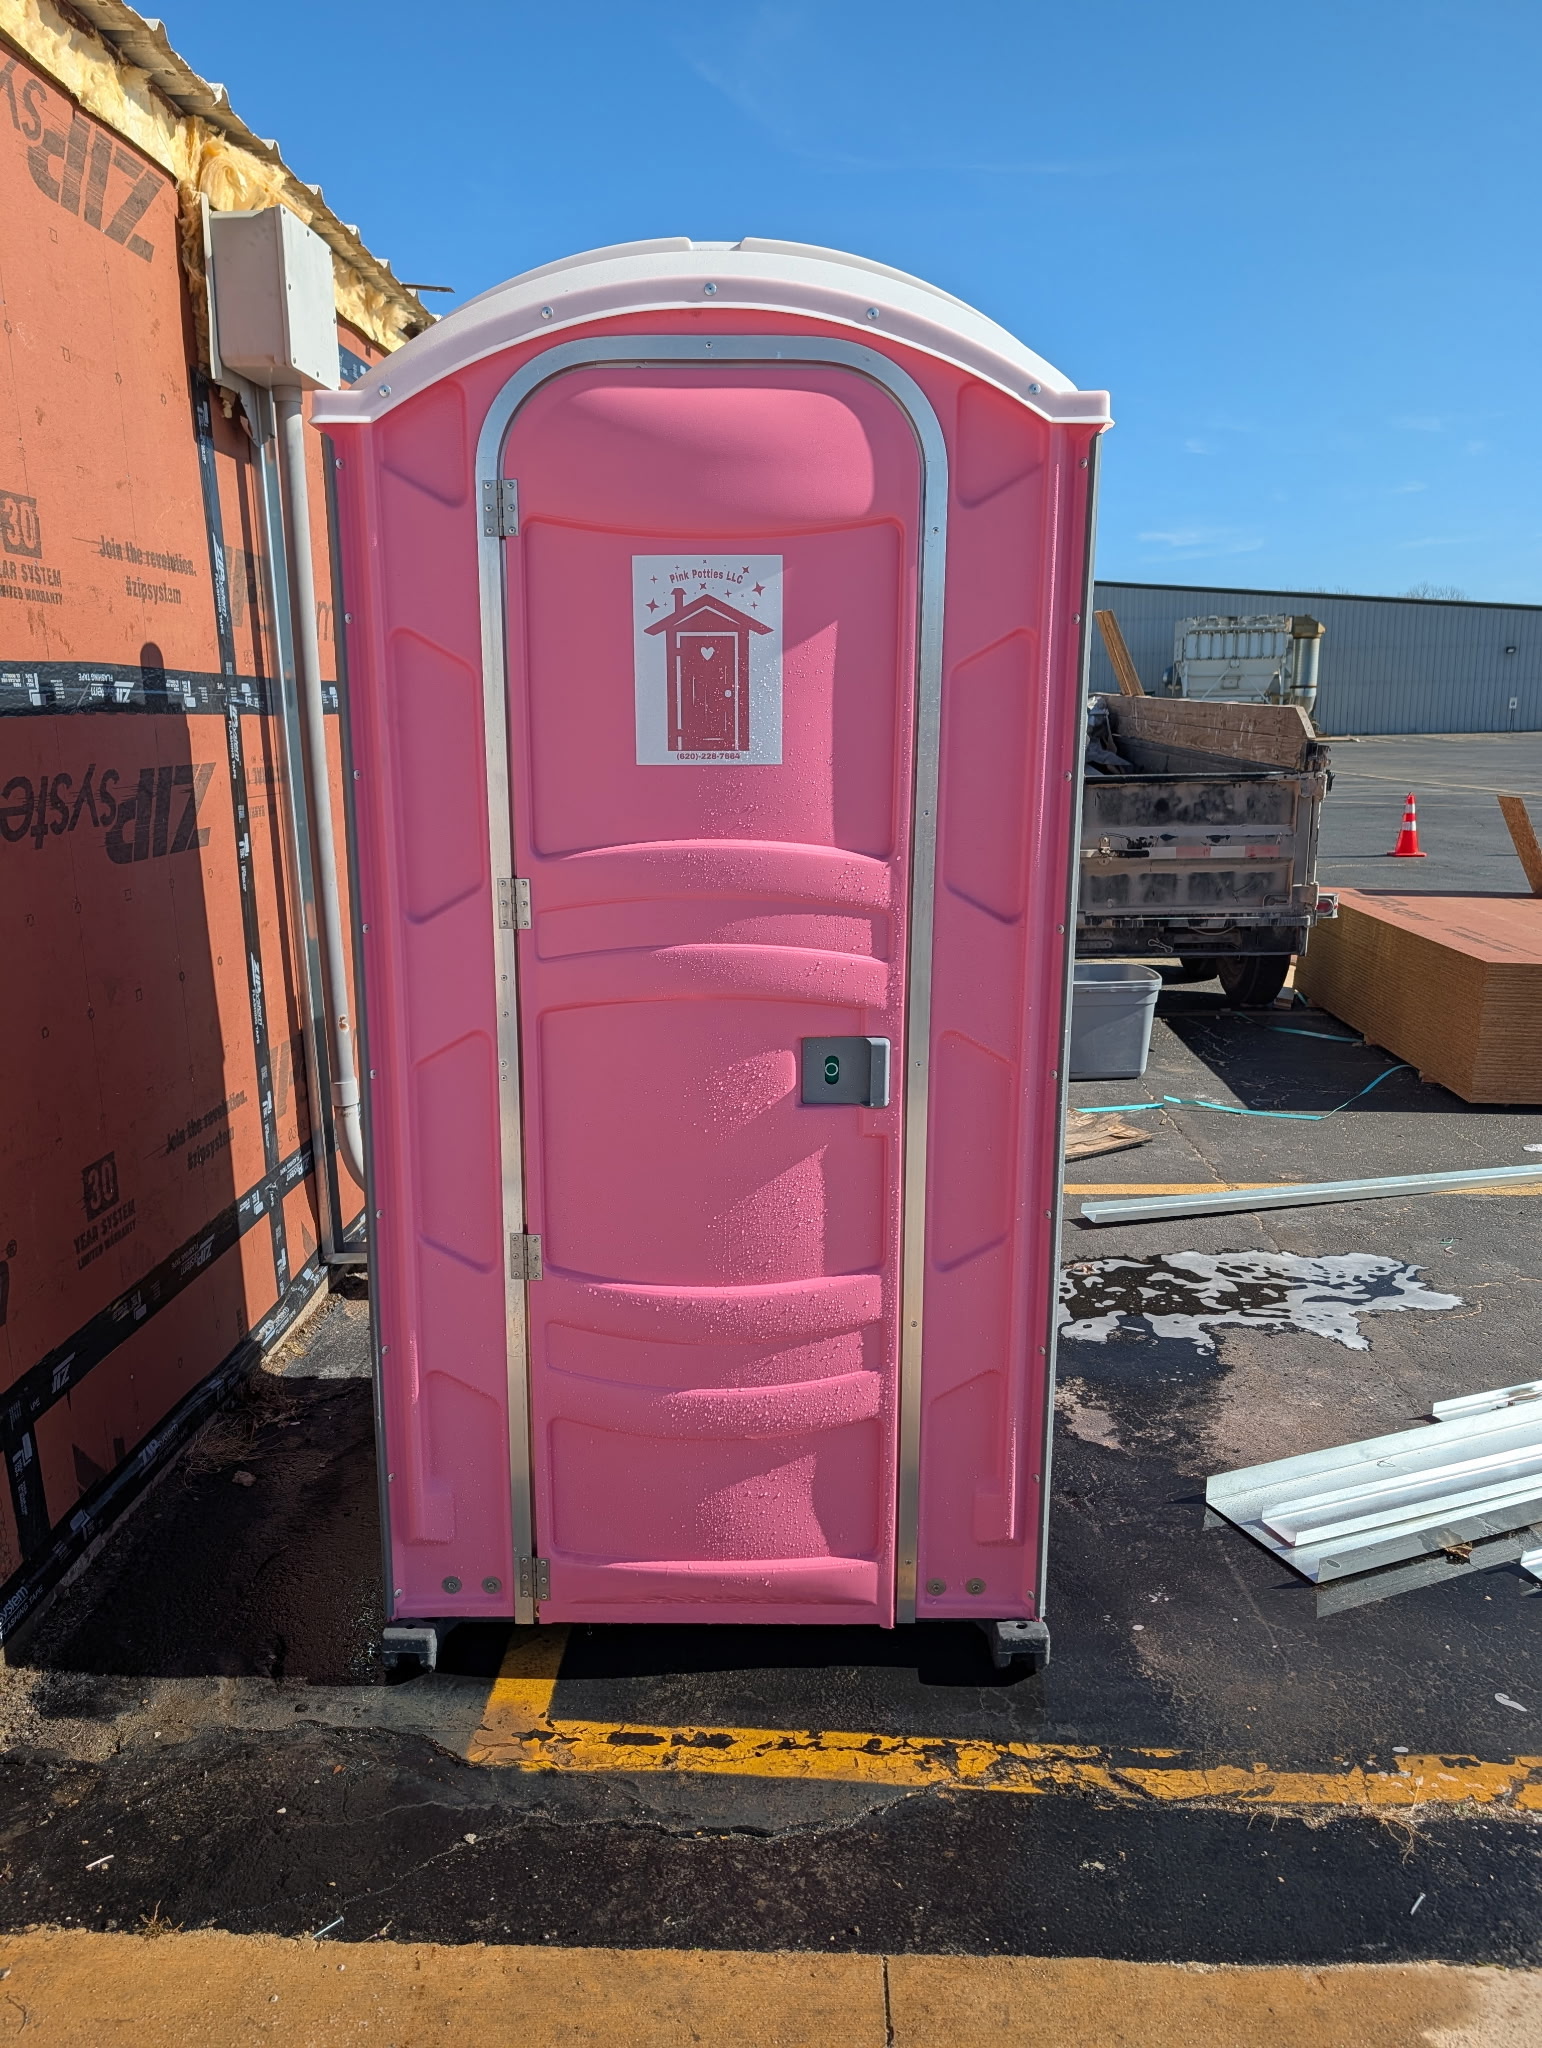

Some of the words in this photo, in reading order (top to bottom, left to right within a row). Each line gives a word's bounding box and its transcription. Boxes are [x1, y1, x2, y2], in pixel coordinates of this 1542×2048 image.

[100, 534, 123, 561] Join
[125, 541, 143, 565] the
[21, 563, 62, 588] SYSTEM
[669, 570, 689, 583] Pink
[692, 569, 723, 579] Potties
[726, 571, 743, 584] LLC
[24, 588, 62, 605] WARRANTY
[125, 575, 181, 605] #zipsystem
[166, 1128, 186, 1154] Join
[73, 1225, 99, 1255] YEAR
[101, 1198, 137, 1236] SYSTEM
